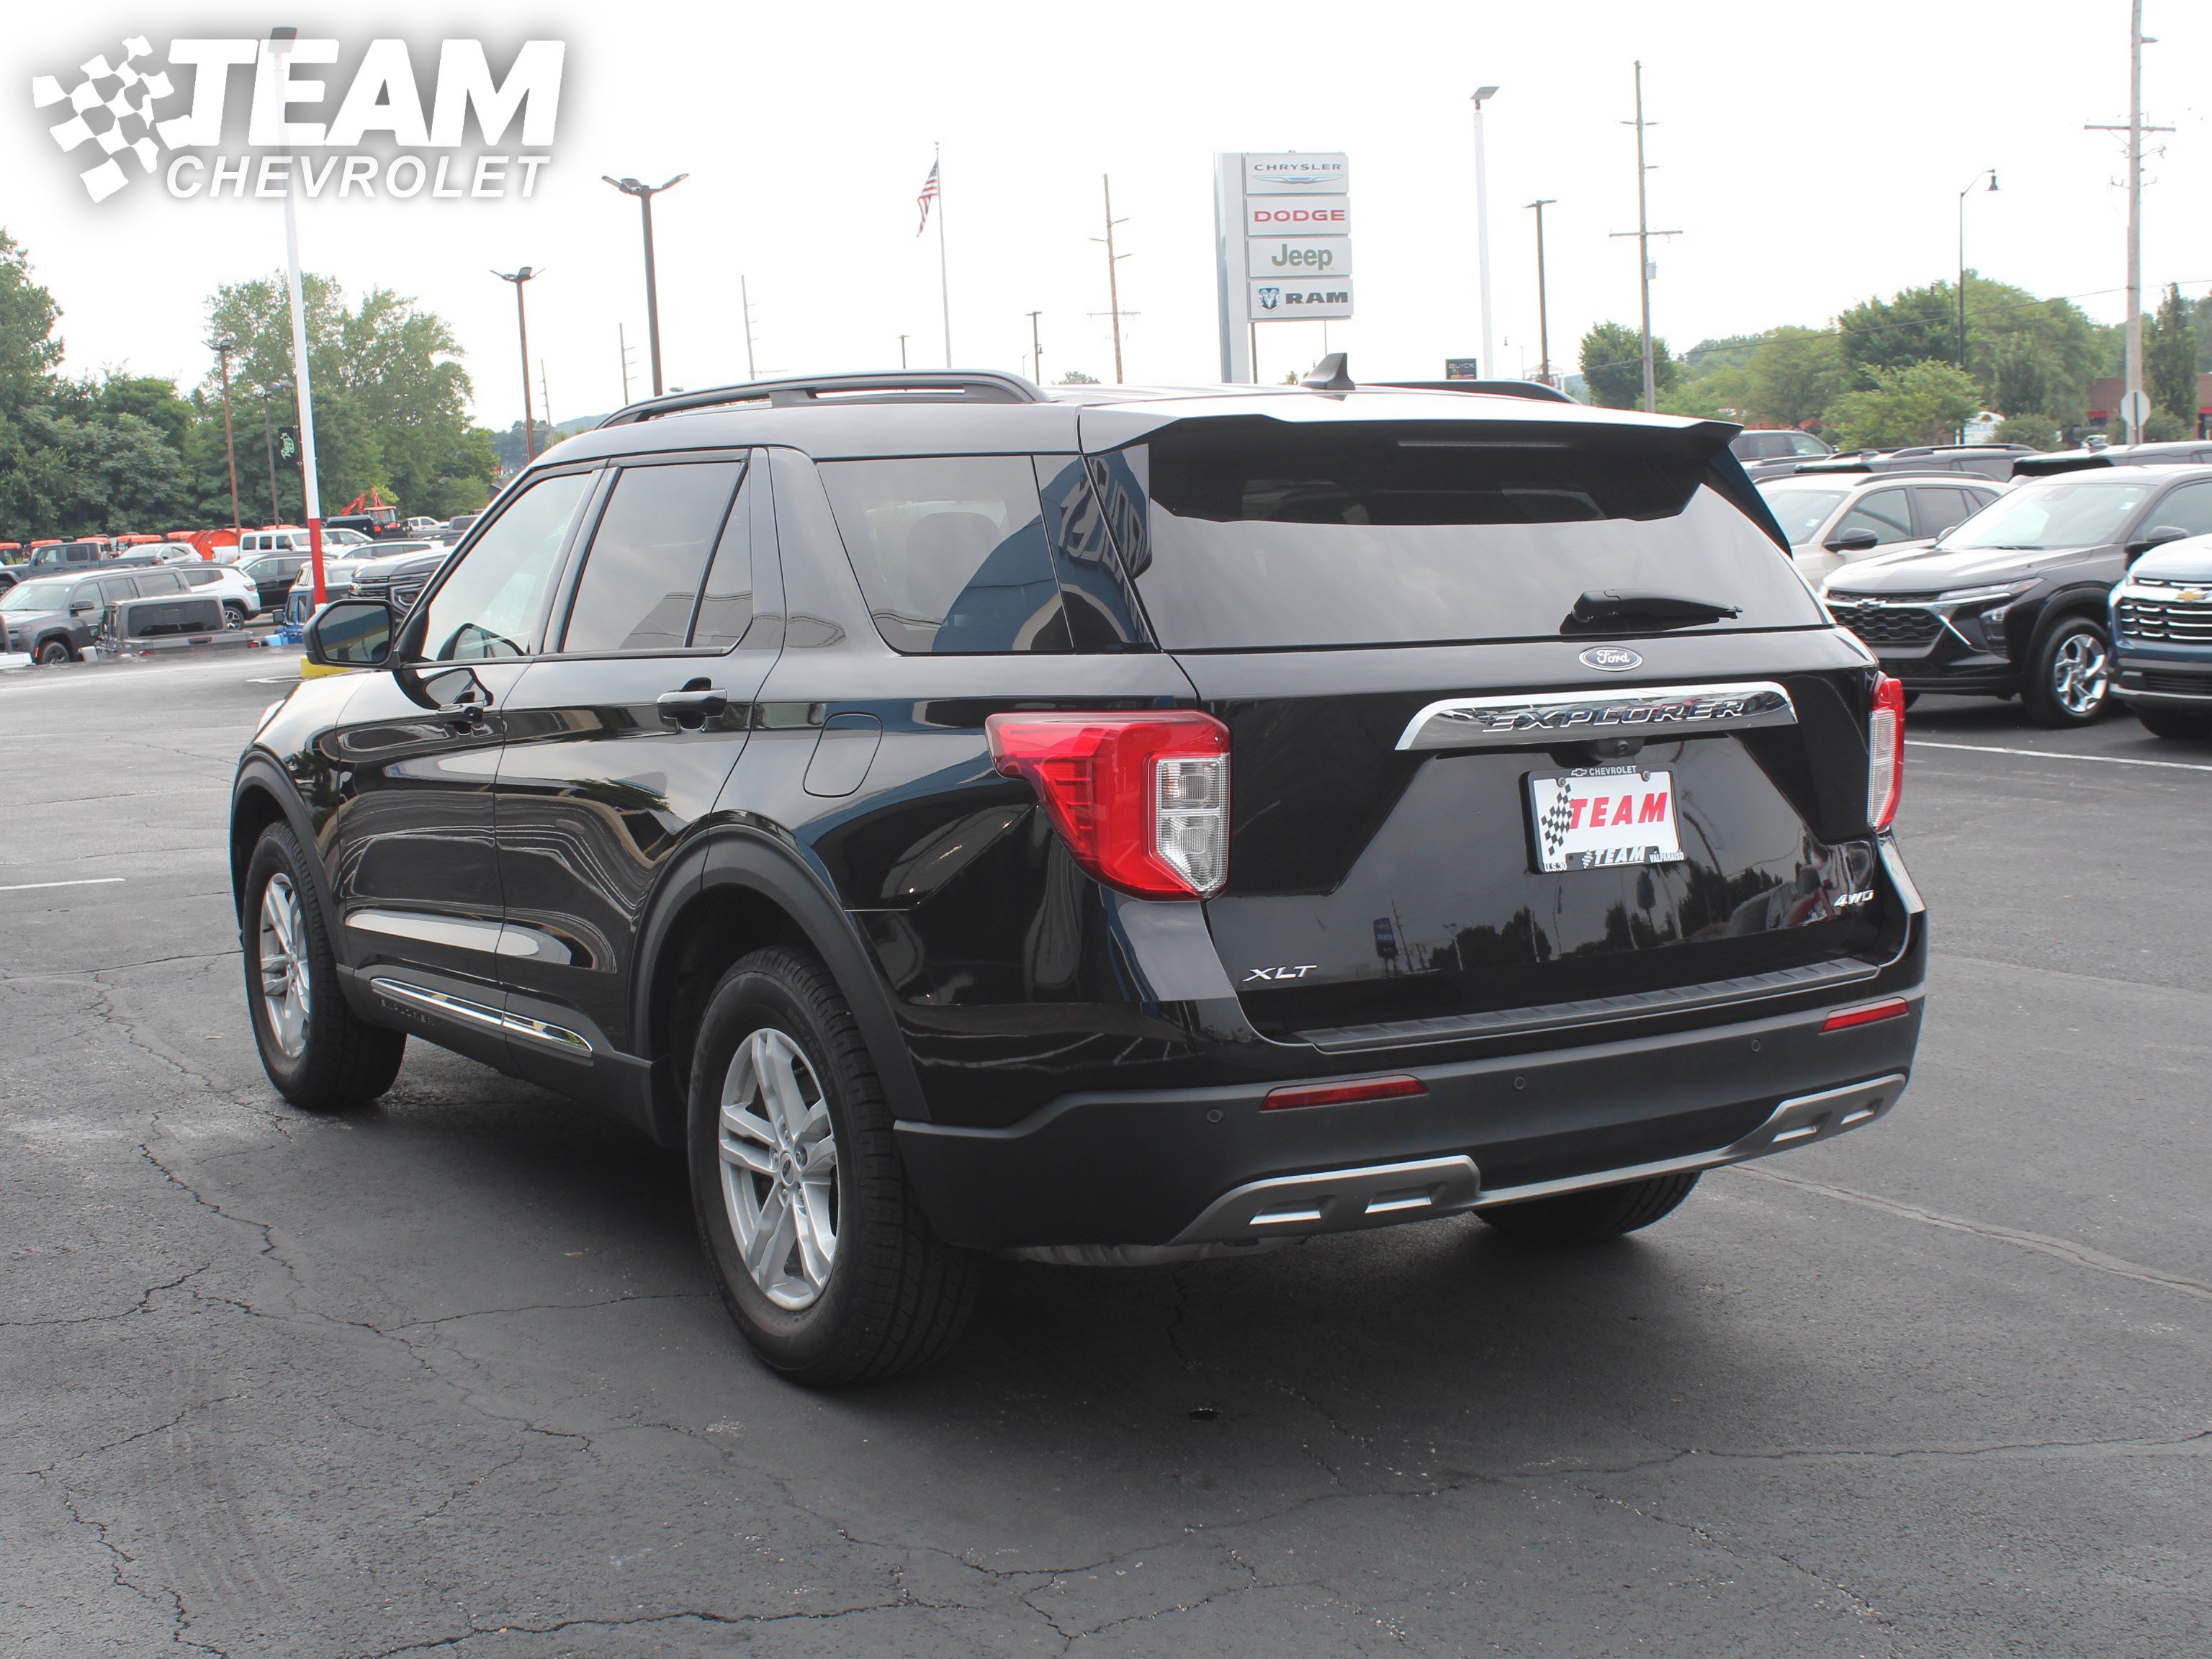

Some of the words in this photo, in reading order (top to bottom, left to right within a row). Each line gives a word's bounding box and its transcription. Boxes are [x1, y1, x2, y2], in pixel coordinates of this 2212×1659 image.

[1254, 210, 1345, 222] DODGE
[1272, 243, 1333, 271] Jeep
[1285, 292, 1348, 305] RAM
[1596, 649, 1630, 664] Ford
[1482, 700, 1744, 732] EXPLORER
[1588, 765, 1637, 776] CHEVROLET
[1569, 792, 1668, 830] TEAM
[1594, 846, 1645, 865] TEAM
[1648, 852, 1684, 863] VALPARAISO
[1833, 890, 1874, 907] 4WD
[1242, 965, 1318, 981] XLT
